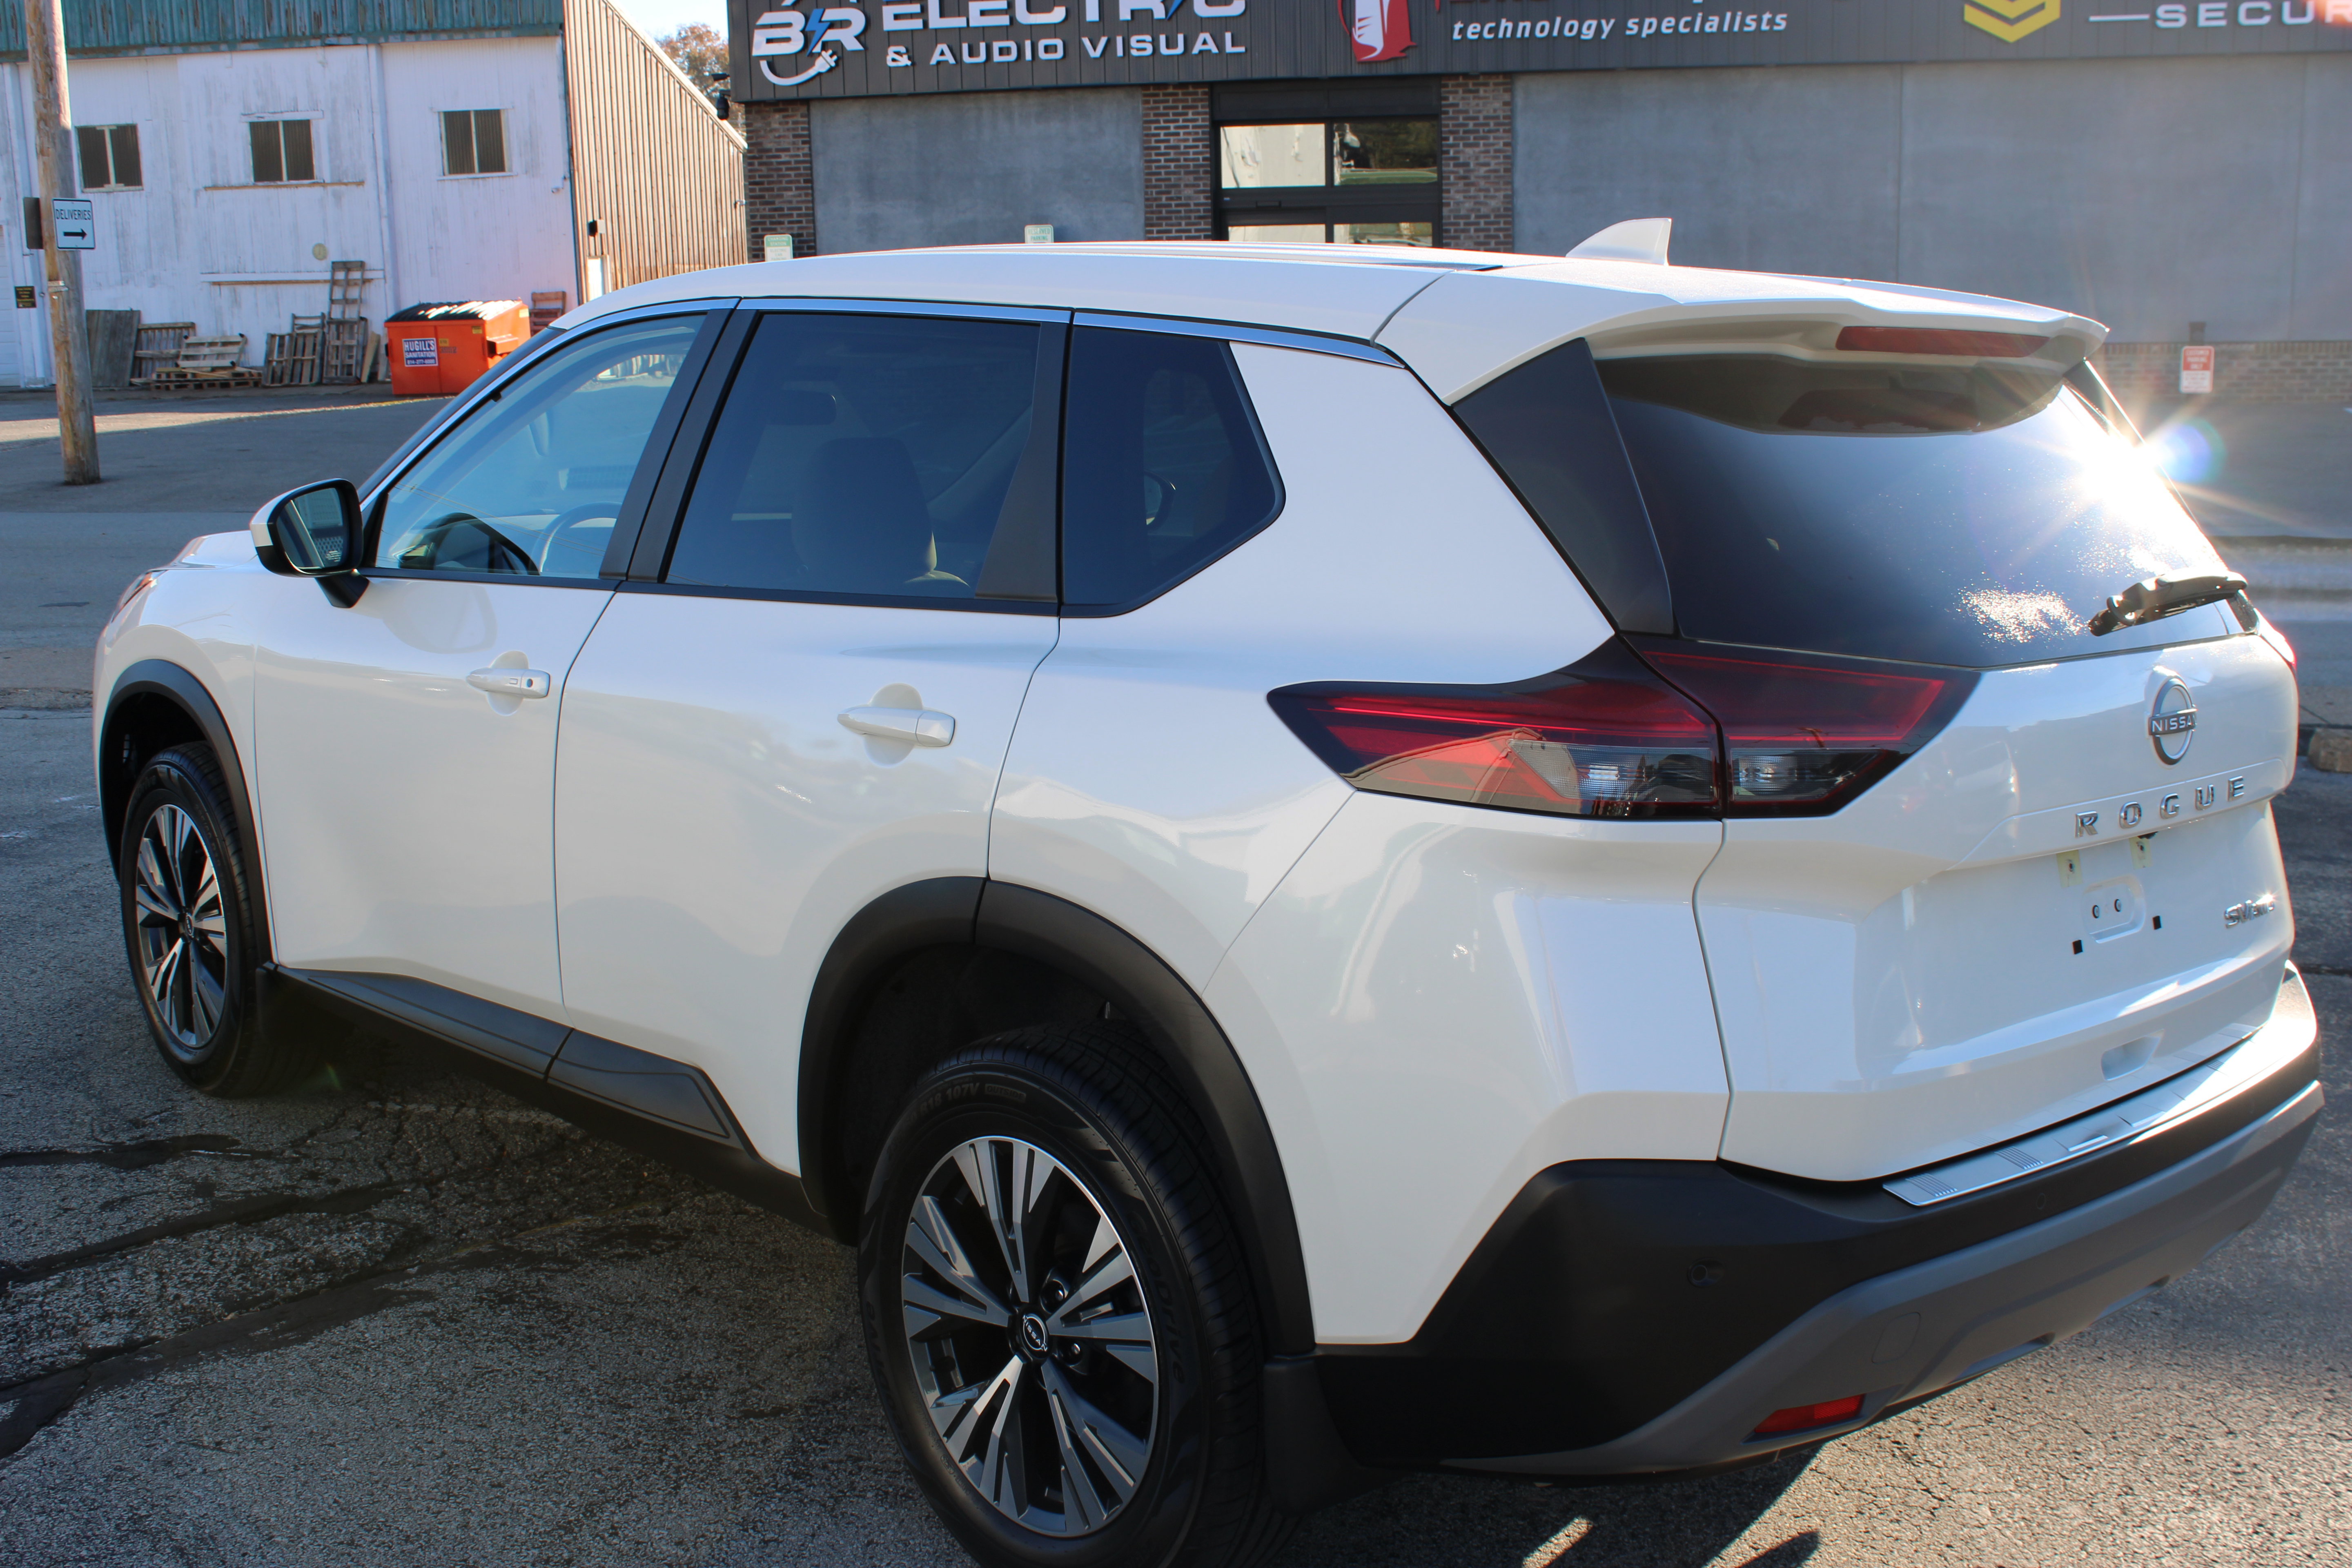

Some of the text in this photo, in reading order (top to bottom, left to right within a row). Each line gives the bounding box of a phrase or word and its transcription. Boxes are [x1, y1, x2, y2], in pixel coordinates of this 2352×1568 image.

[1452, 11, 1788, 40] technology specialists
[886, 31, 1246, 67] & AUDIO VISUAL
[56, 209, 91, 220] DELIVERIES
[404, 340, 435, 352] HUGILL'S
[2075, 776, 2245, 837] ROGUE
[920, 1092, 942, 1116] R18
[946, 1082, 980, 1102] 107V
[986, 1084, 1025, 1100] OUTSIDE
[1022, 1314, 1048, 1352] NISSAN
